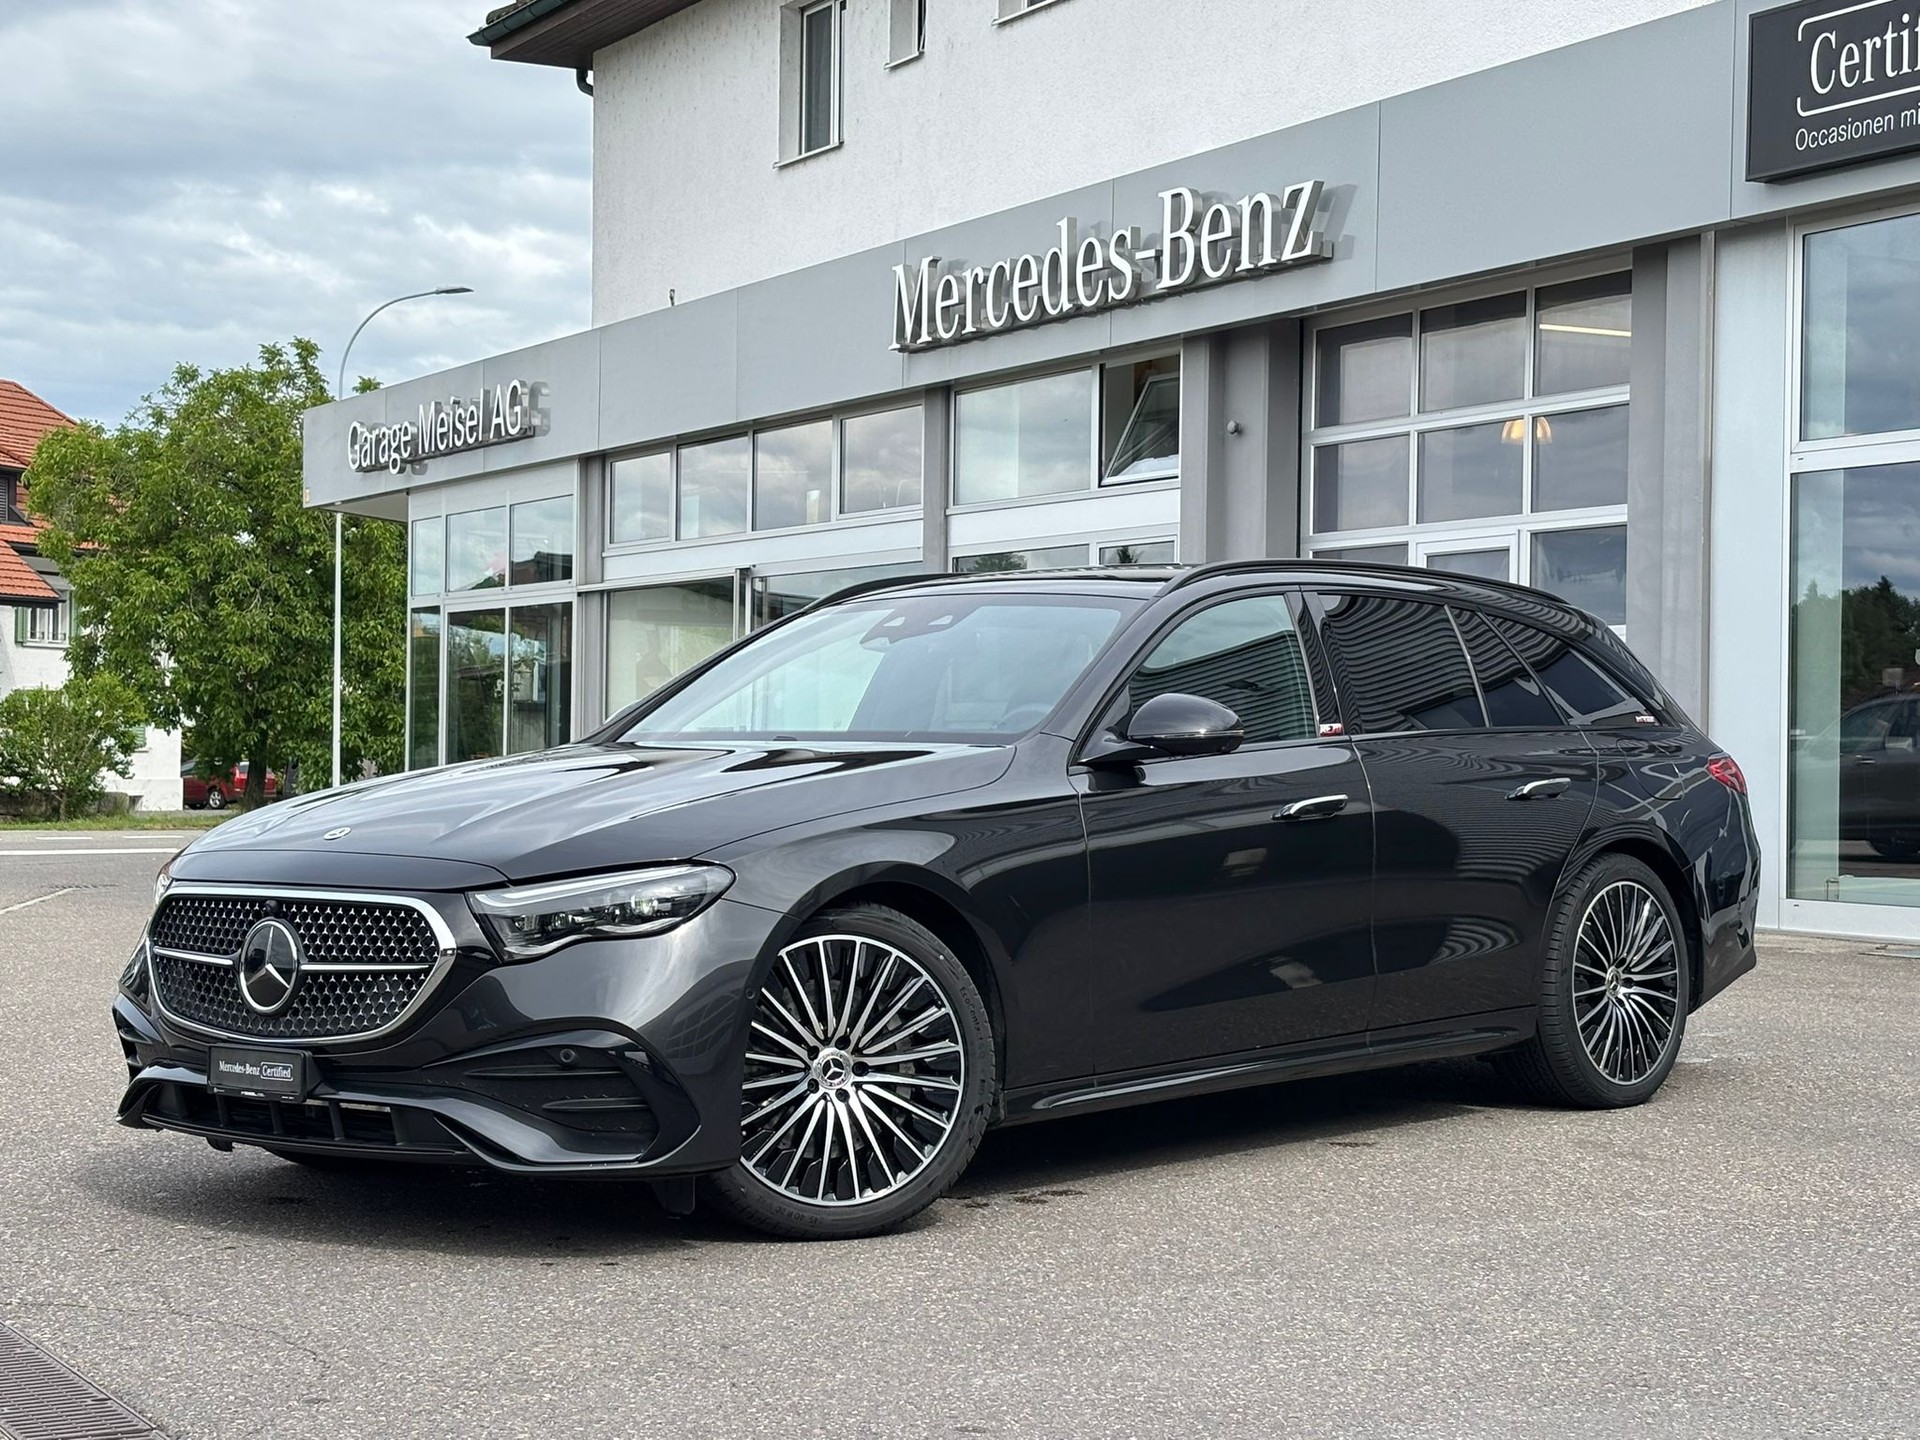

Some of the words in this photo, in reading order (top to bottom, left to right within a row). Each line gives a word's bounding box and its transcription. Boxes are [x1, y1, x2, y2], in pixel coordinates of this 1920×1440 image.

[1795, 114, 1894, 151] Occasionen
[888, 180, 1326, 351] Mercedes-Benz
[347, 420, 412, 475] Garage
[418, 387, 485, 455] Meisel
[489, 378, 522, 440] AG
[219, 1061, 260, 1076] Mercedes-Benz
[262, 1065, 292, 1078] Certified
